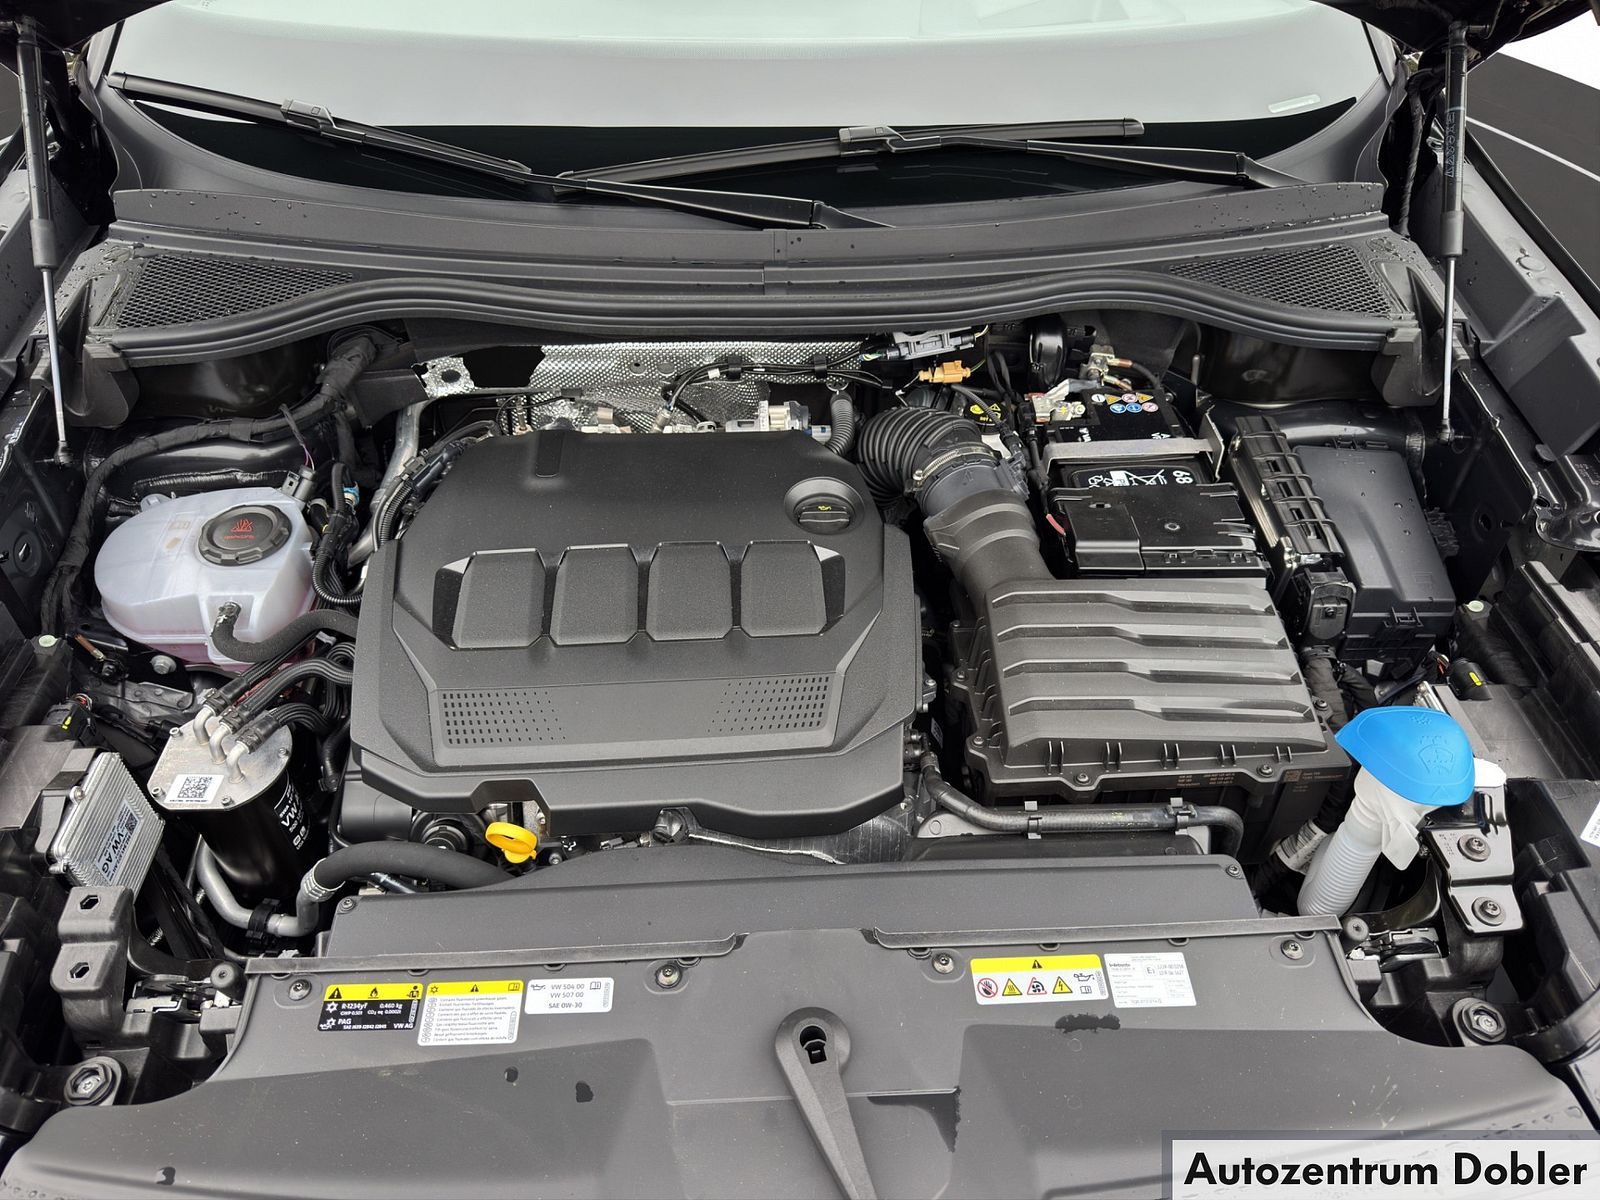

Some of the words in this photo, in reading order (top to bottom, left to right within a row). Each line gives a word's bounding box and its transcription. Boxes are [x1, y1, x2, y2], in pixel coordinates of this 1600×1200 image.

[1172, 470, 1192, 485] 68
[281, 802, 297, 826] VW
[112, 832, 124, 854] VW
[102, 852, 112, 873] AG
